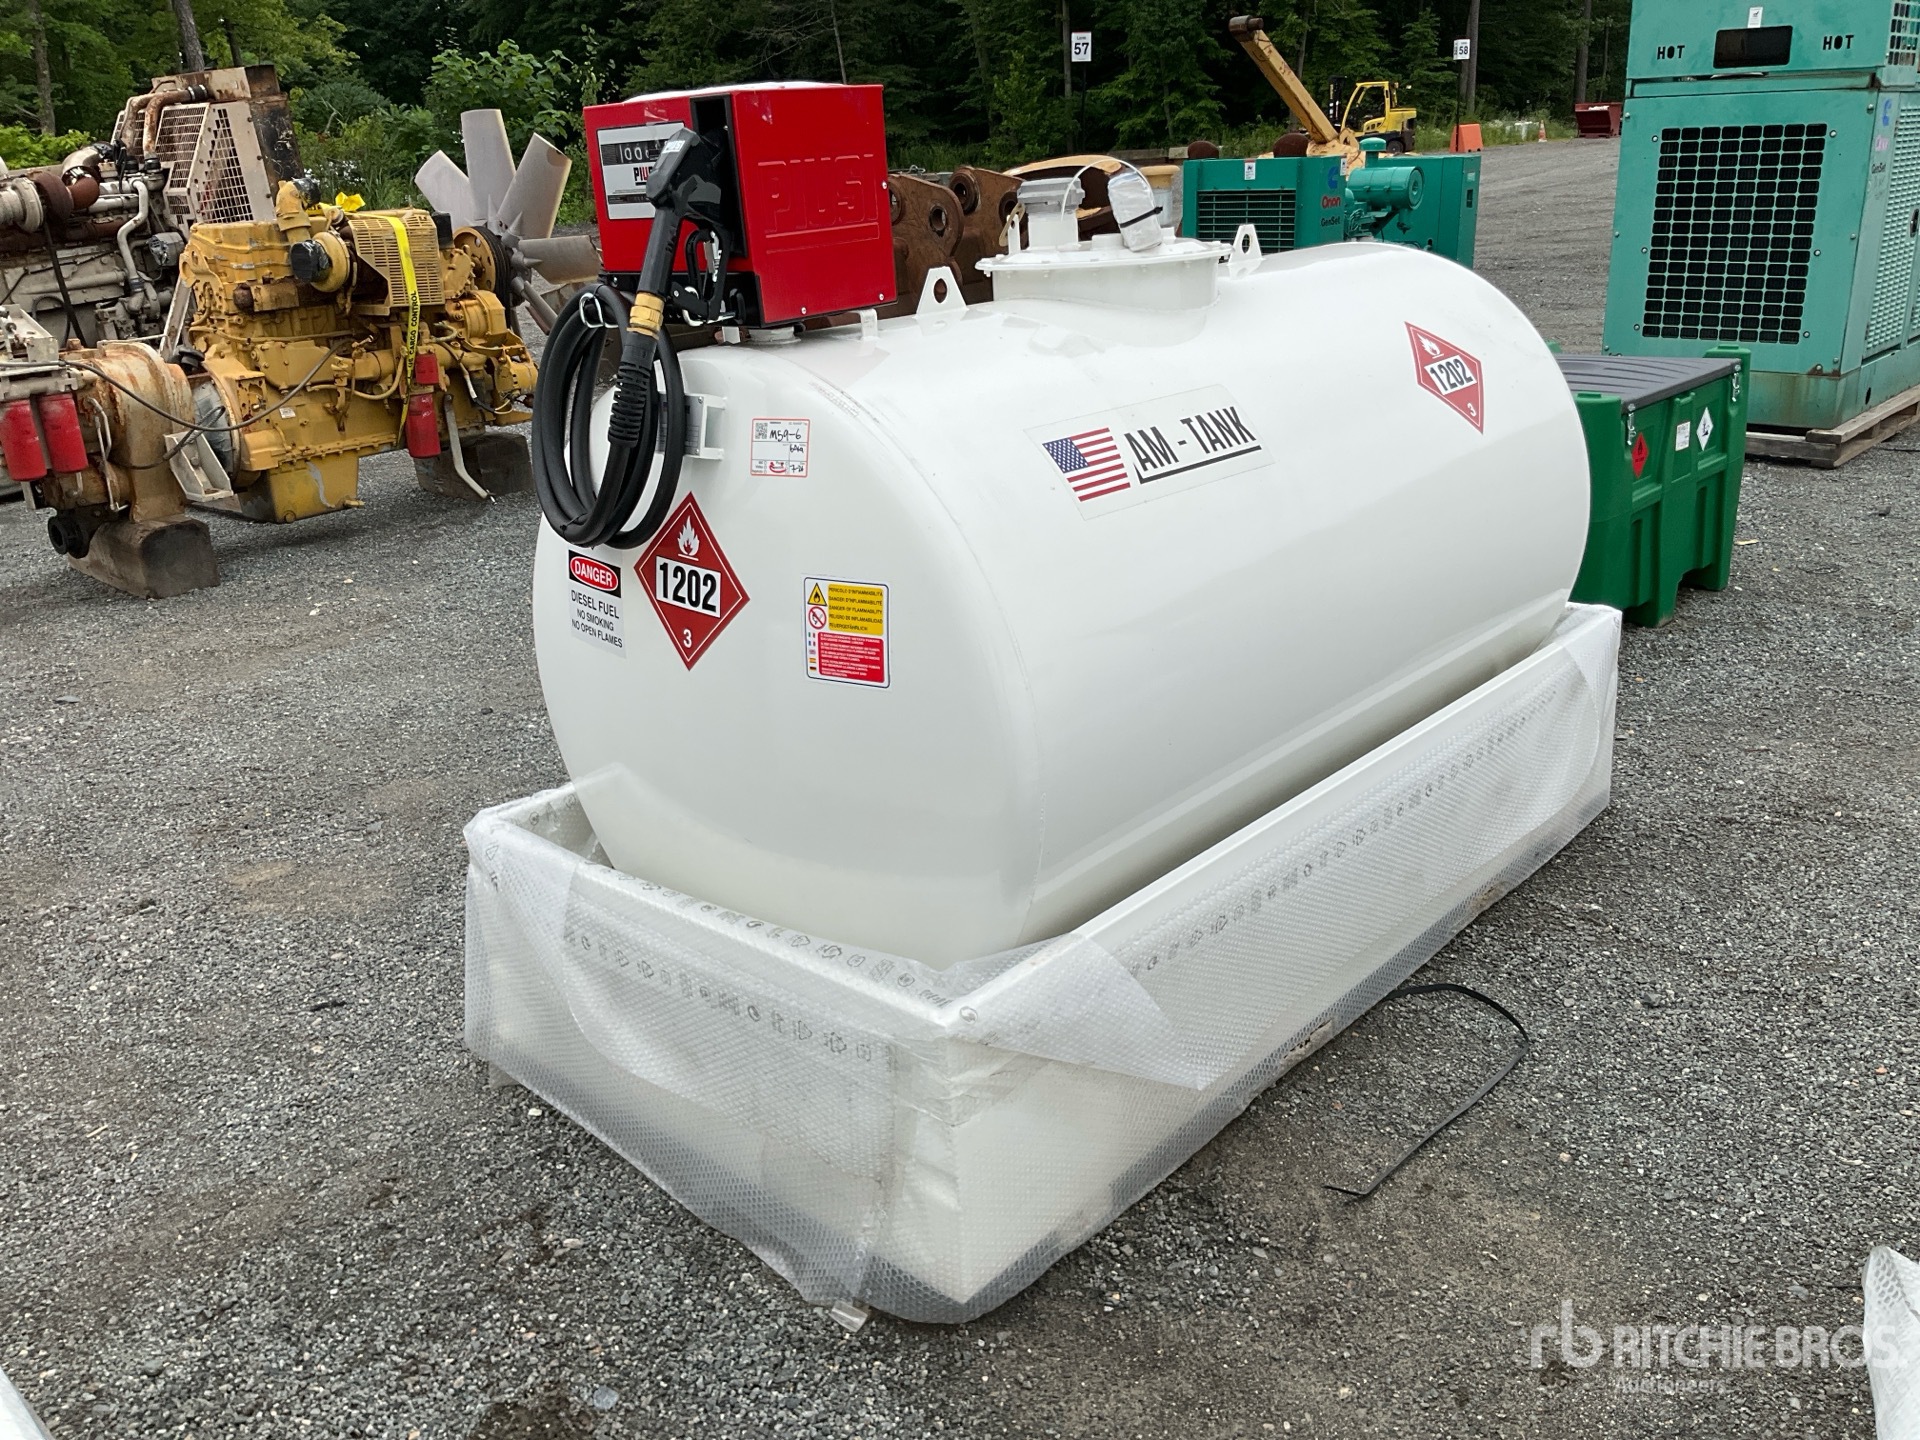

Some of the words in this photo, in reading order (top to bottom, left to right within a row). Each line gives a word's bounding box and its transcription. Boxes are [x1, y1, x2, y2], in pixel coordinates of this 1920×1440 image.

[1074, 42, 1090, 55] 57
[1458, 45, 1469, 55] 58
[1657, 45, 1685, 60] HOT
[1822, 34, 1855, 51] HOT
[1429, 358, 1474, 392] 1202
[1466, 402, 1477, 417] 3
[1123, 426, 1180, 472] AM
[1179, 406, 1257, 455] TANK
[573, 560, 613, 588] DANGER
[659, 562, 717, 613] 1202
[571, 590, 598, 611] DIESEL
[598, 600, 620, 619] FUEL
[576, 609, 586, 620] NO
[586, 613, 615, 632] SMOKING
[571, 619, 581, 631] NO
[581, 621, 597, 637] OPEN
[597, 630, 623, 649] FLAMES
[683, 628, 693, 649] 3
